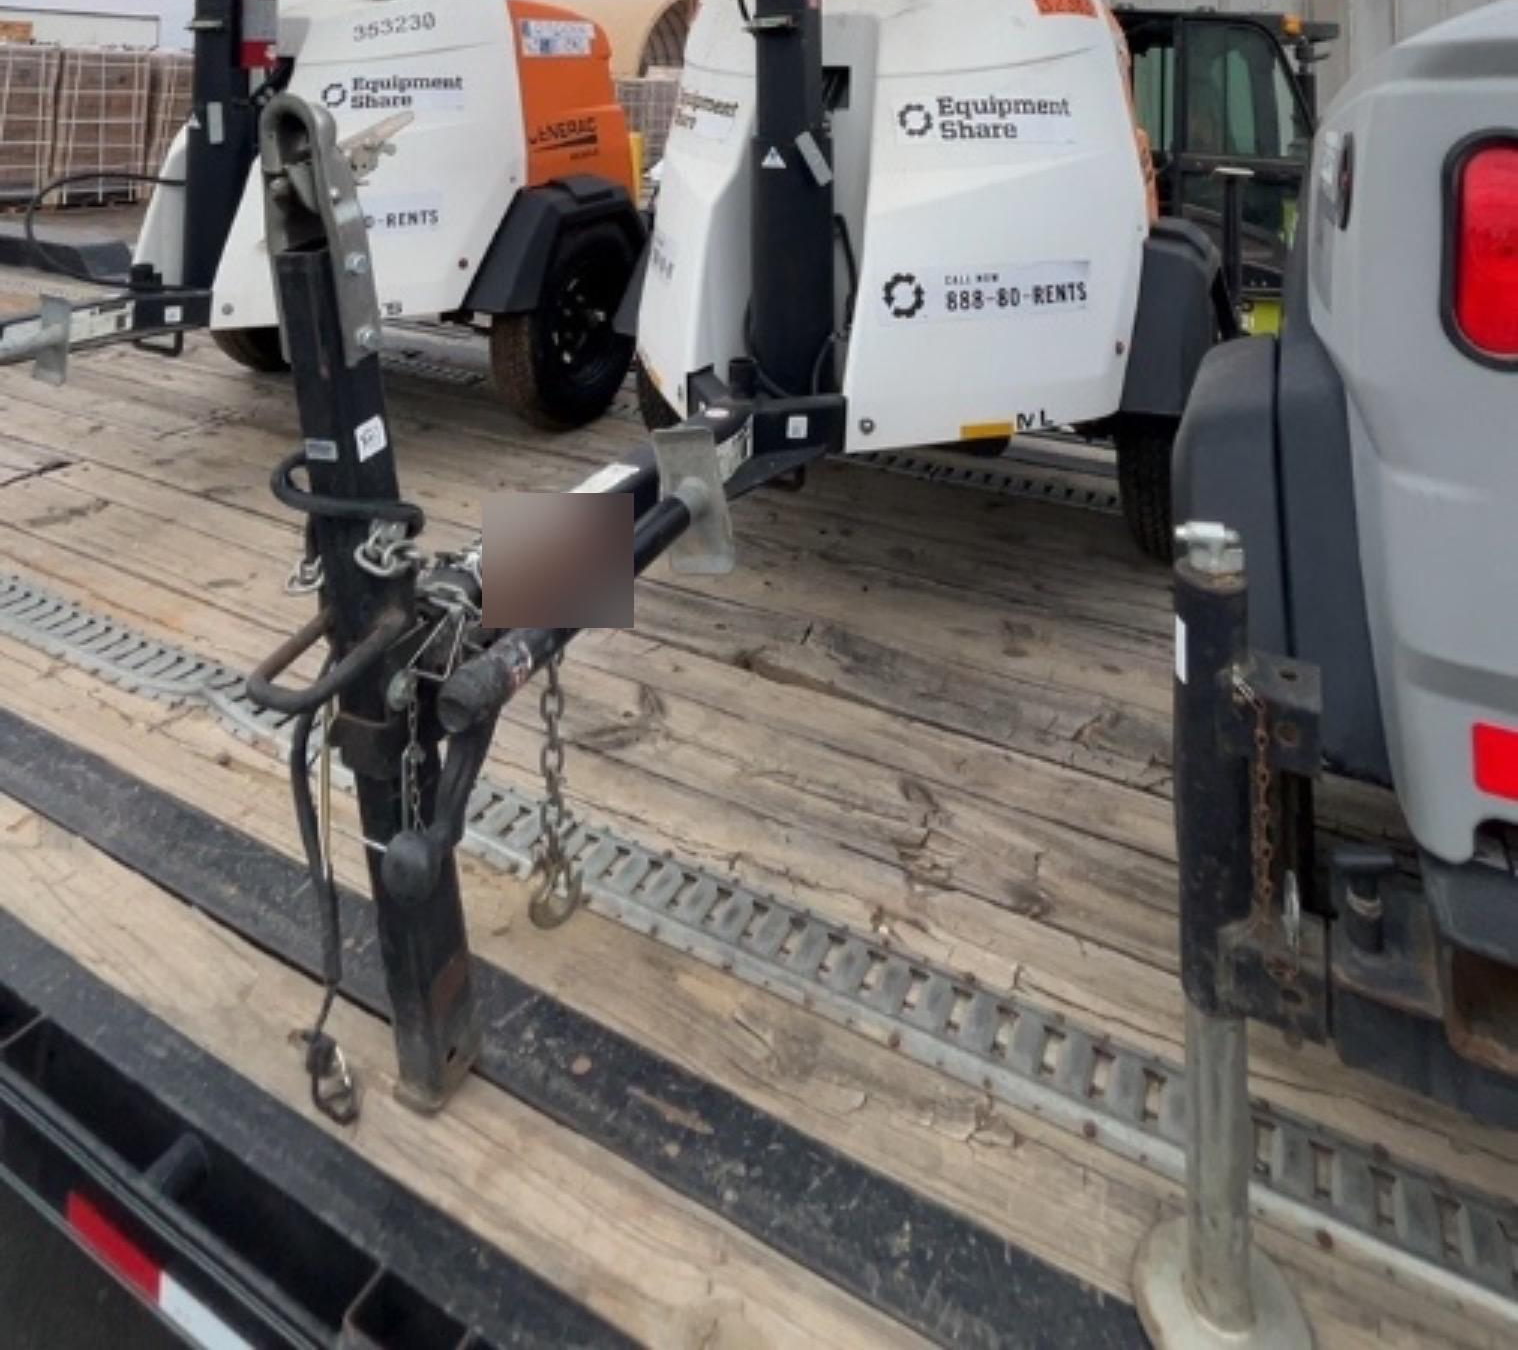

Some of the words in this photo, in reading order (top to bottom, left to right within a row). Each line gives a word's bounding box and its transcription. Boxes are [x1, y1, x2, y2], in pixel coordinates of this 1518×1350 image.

[352, 11, 437, 42] 353230
[351, 74, 464, 93] Equipment
[350, 94, 413, 109] Share
[936, 96, 1072, 119] Equipment
[941, 119, 1018, 140] Share
